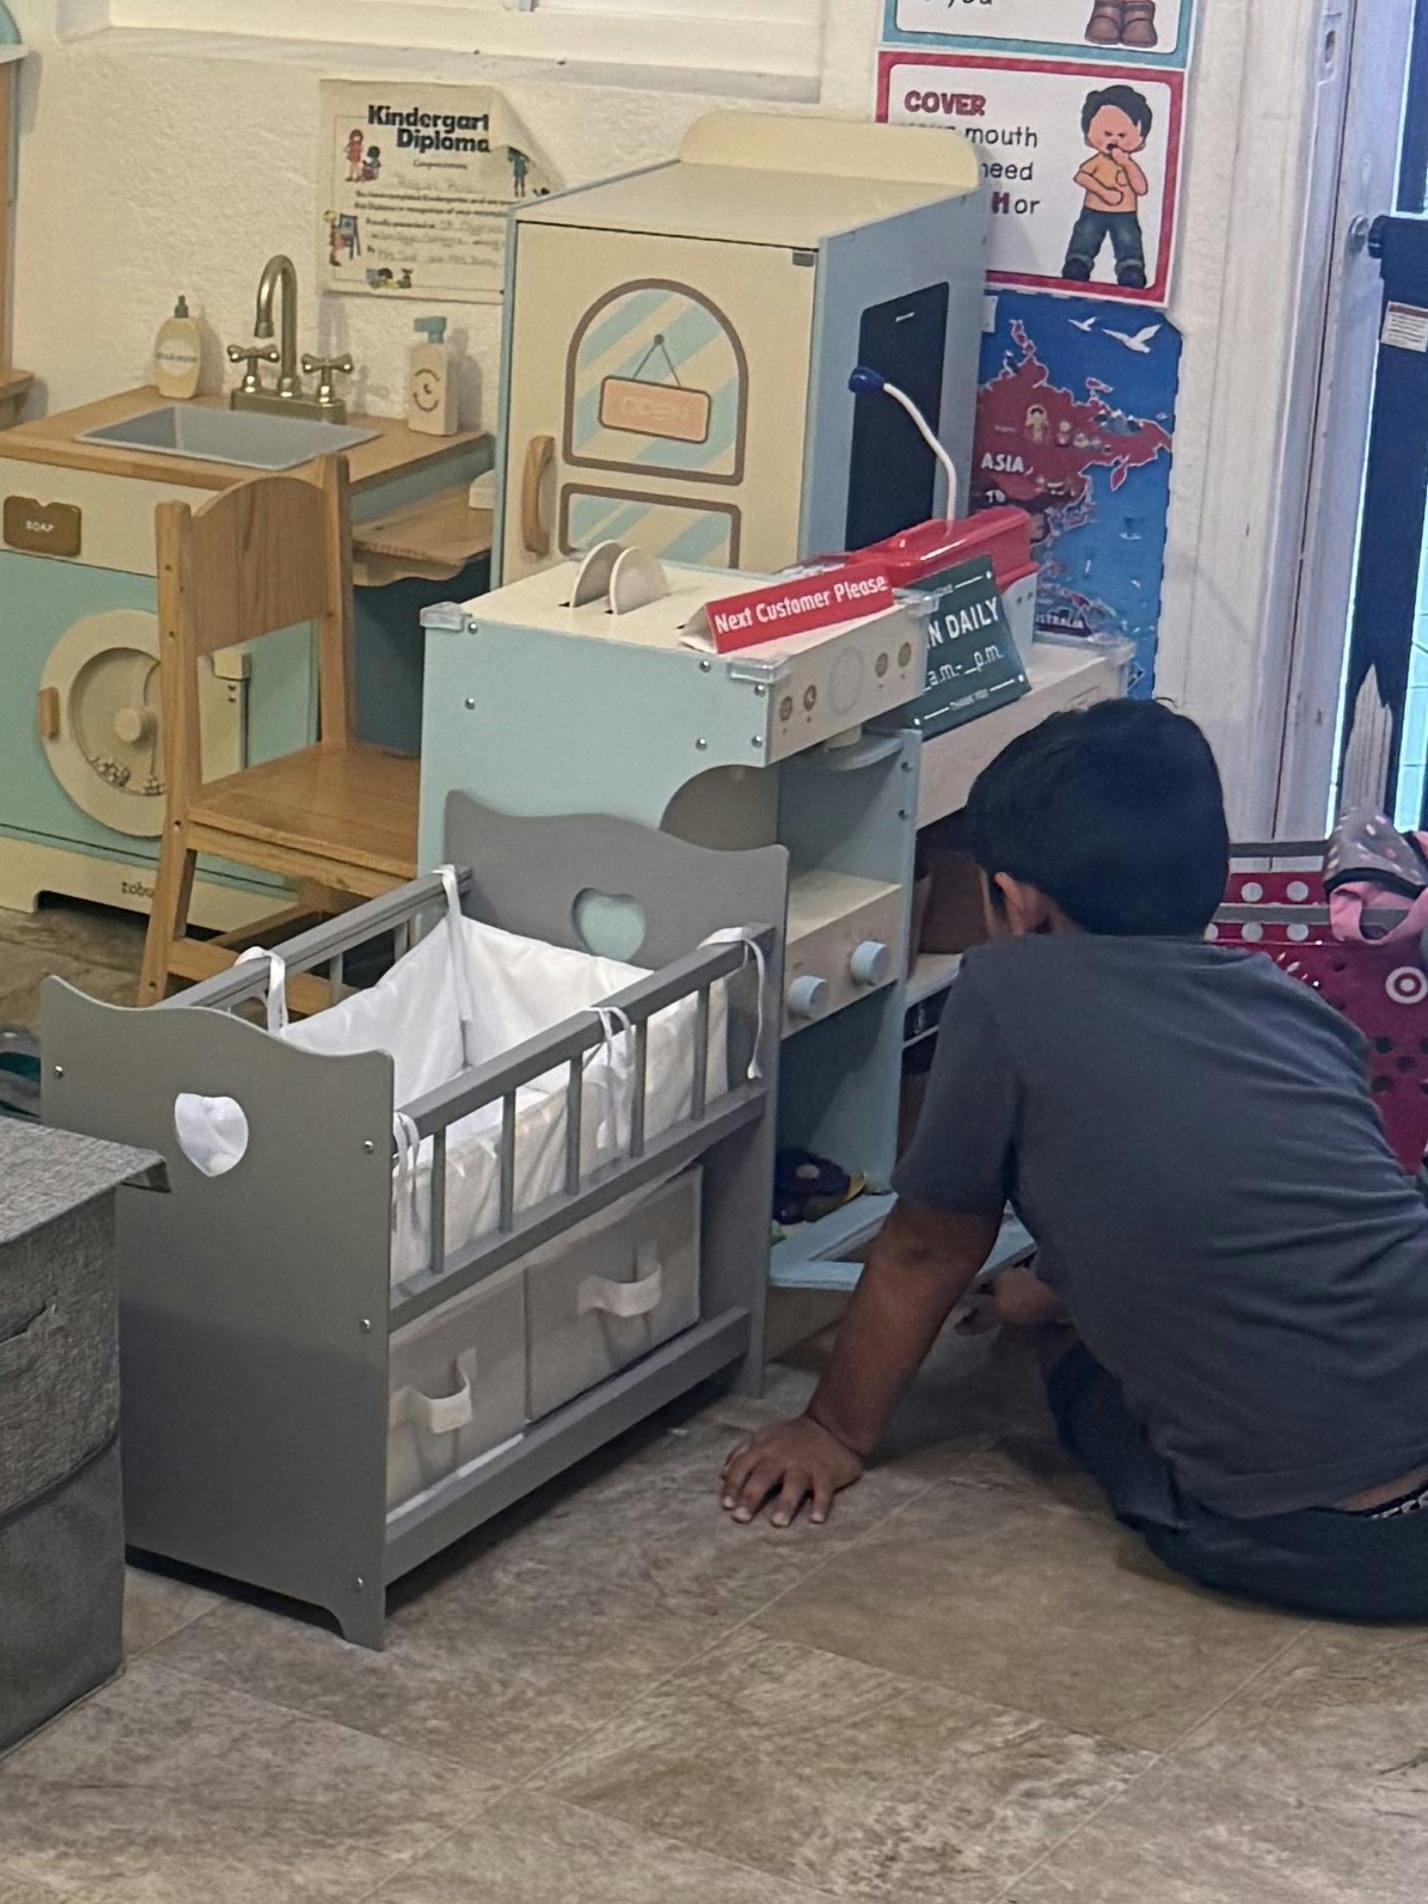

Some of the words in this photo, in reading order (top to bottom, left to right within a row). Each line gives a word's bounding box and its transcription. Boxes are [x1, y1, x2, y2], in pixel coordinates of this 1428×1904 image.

[904, 90, 986, 116] COVER
[397, 128, 491, 154] Diploma
[965, 126, 1038, 148] mouth
[1015, 198, 1040, 215] or
[715, 611, 752, 634] Next
[756, 590, 829, 623] Customer
[834, 576, 888, 602] Please
[946, 597, 999, 639] DAILY
